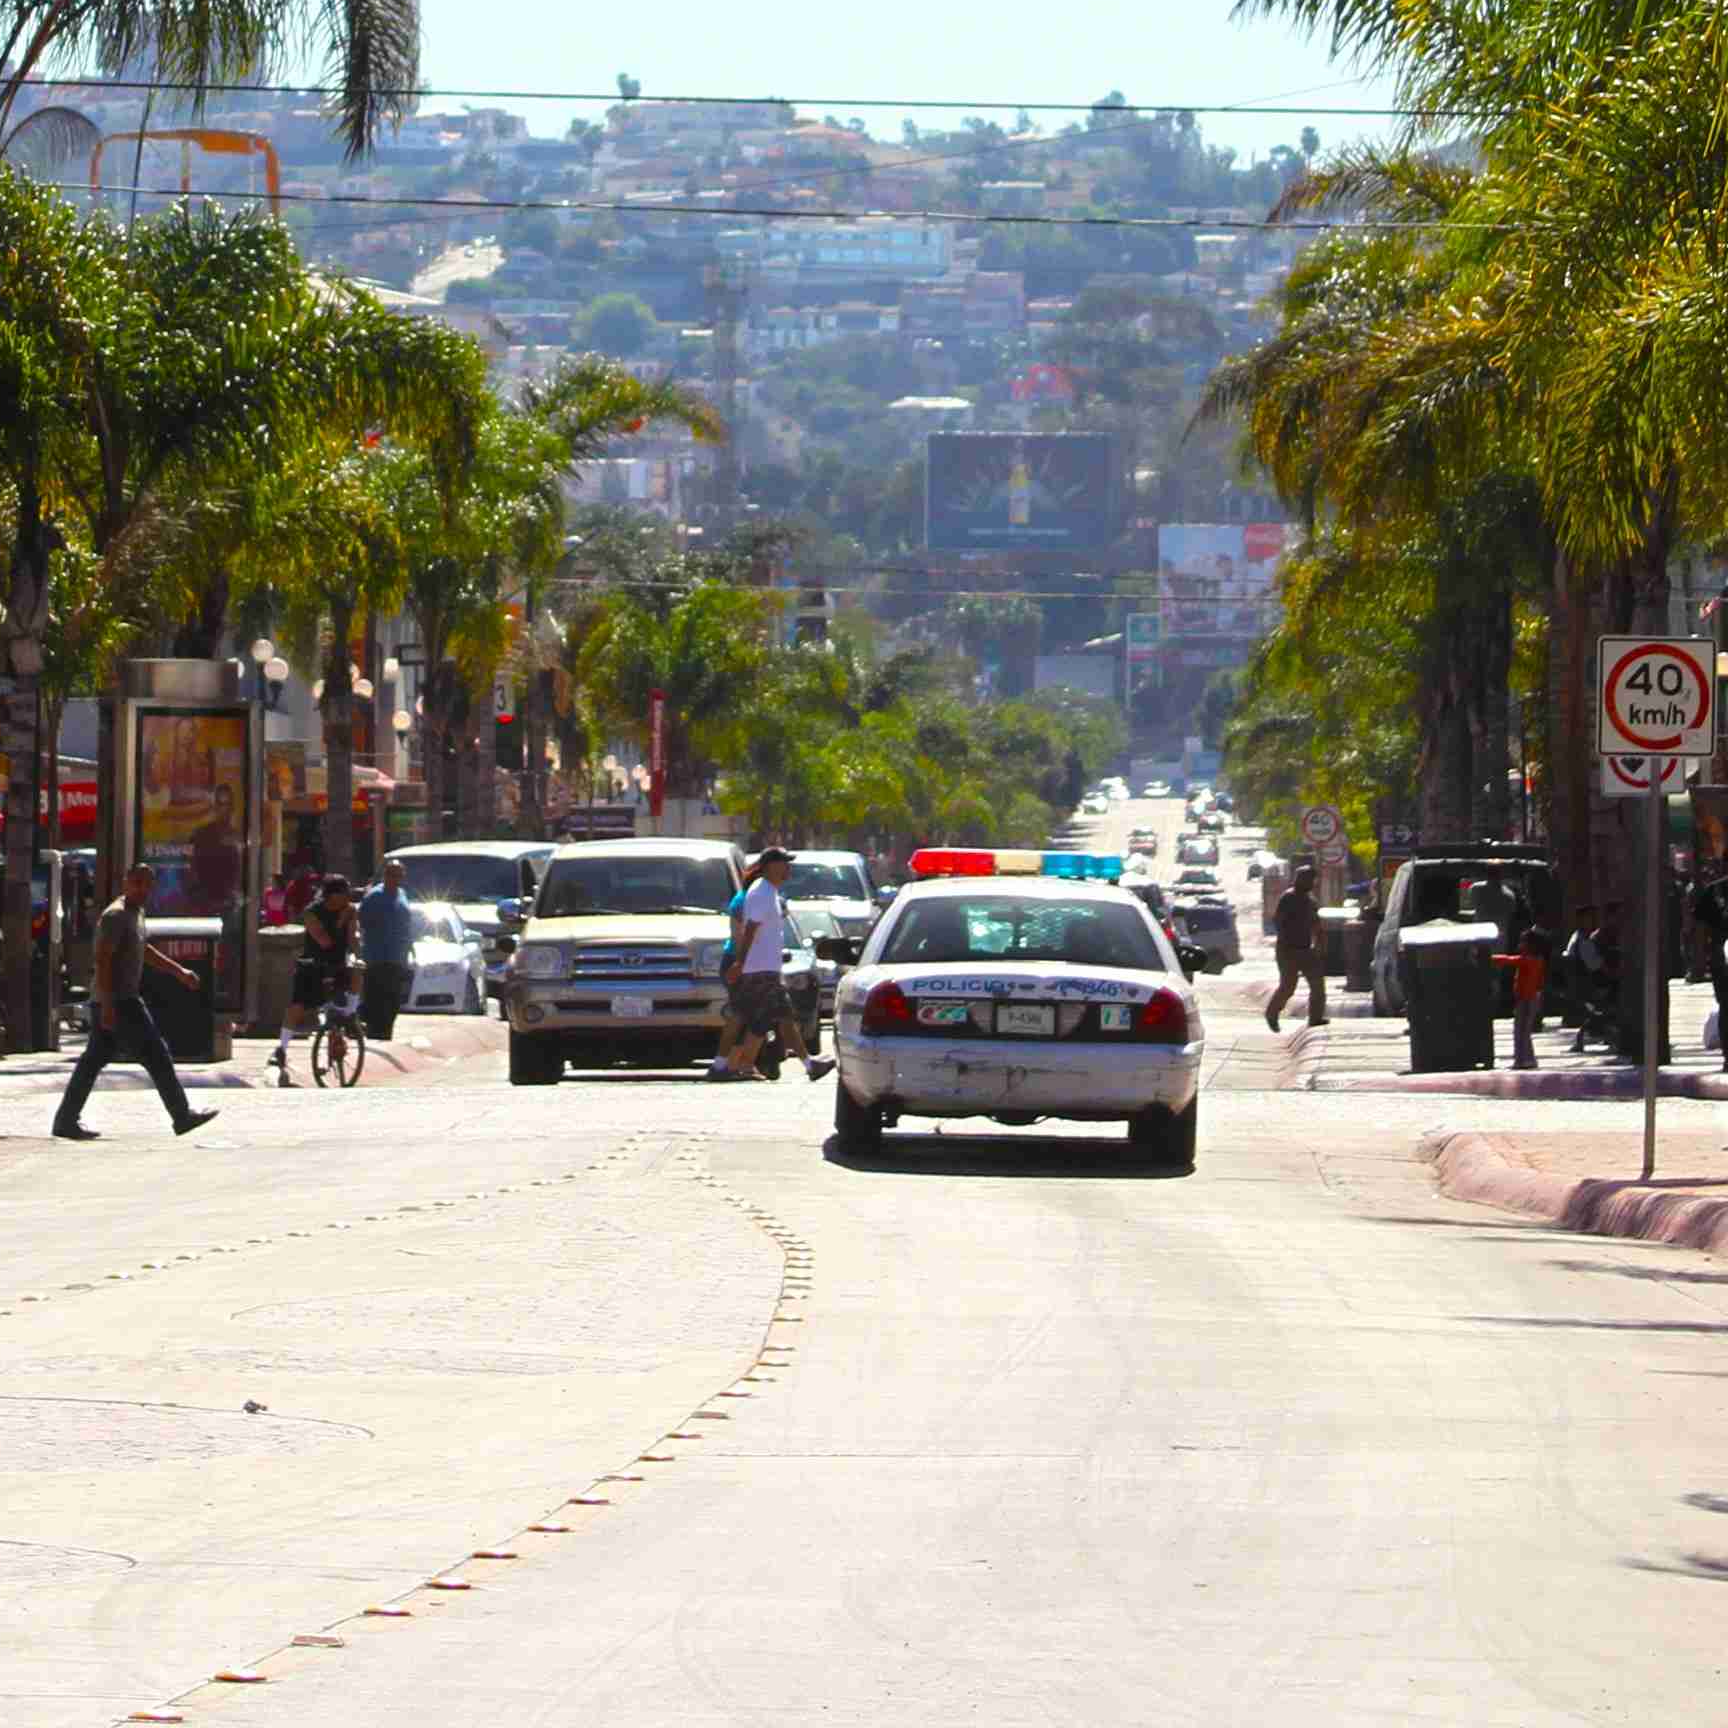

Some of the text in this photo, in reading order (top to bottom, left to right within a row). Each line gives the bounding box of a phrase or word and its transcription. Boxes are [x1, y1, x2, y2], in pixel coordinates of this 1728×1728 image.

[1625, 662, 1683, 696] 40
[1629, 703, 1686, 726] km/h
[1310, 815, 1330, 826] 40
[911, 978, 1006, 994] POLICIA
